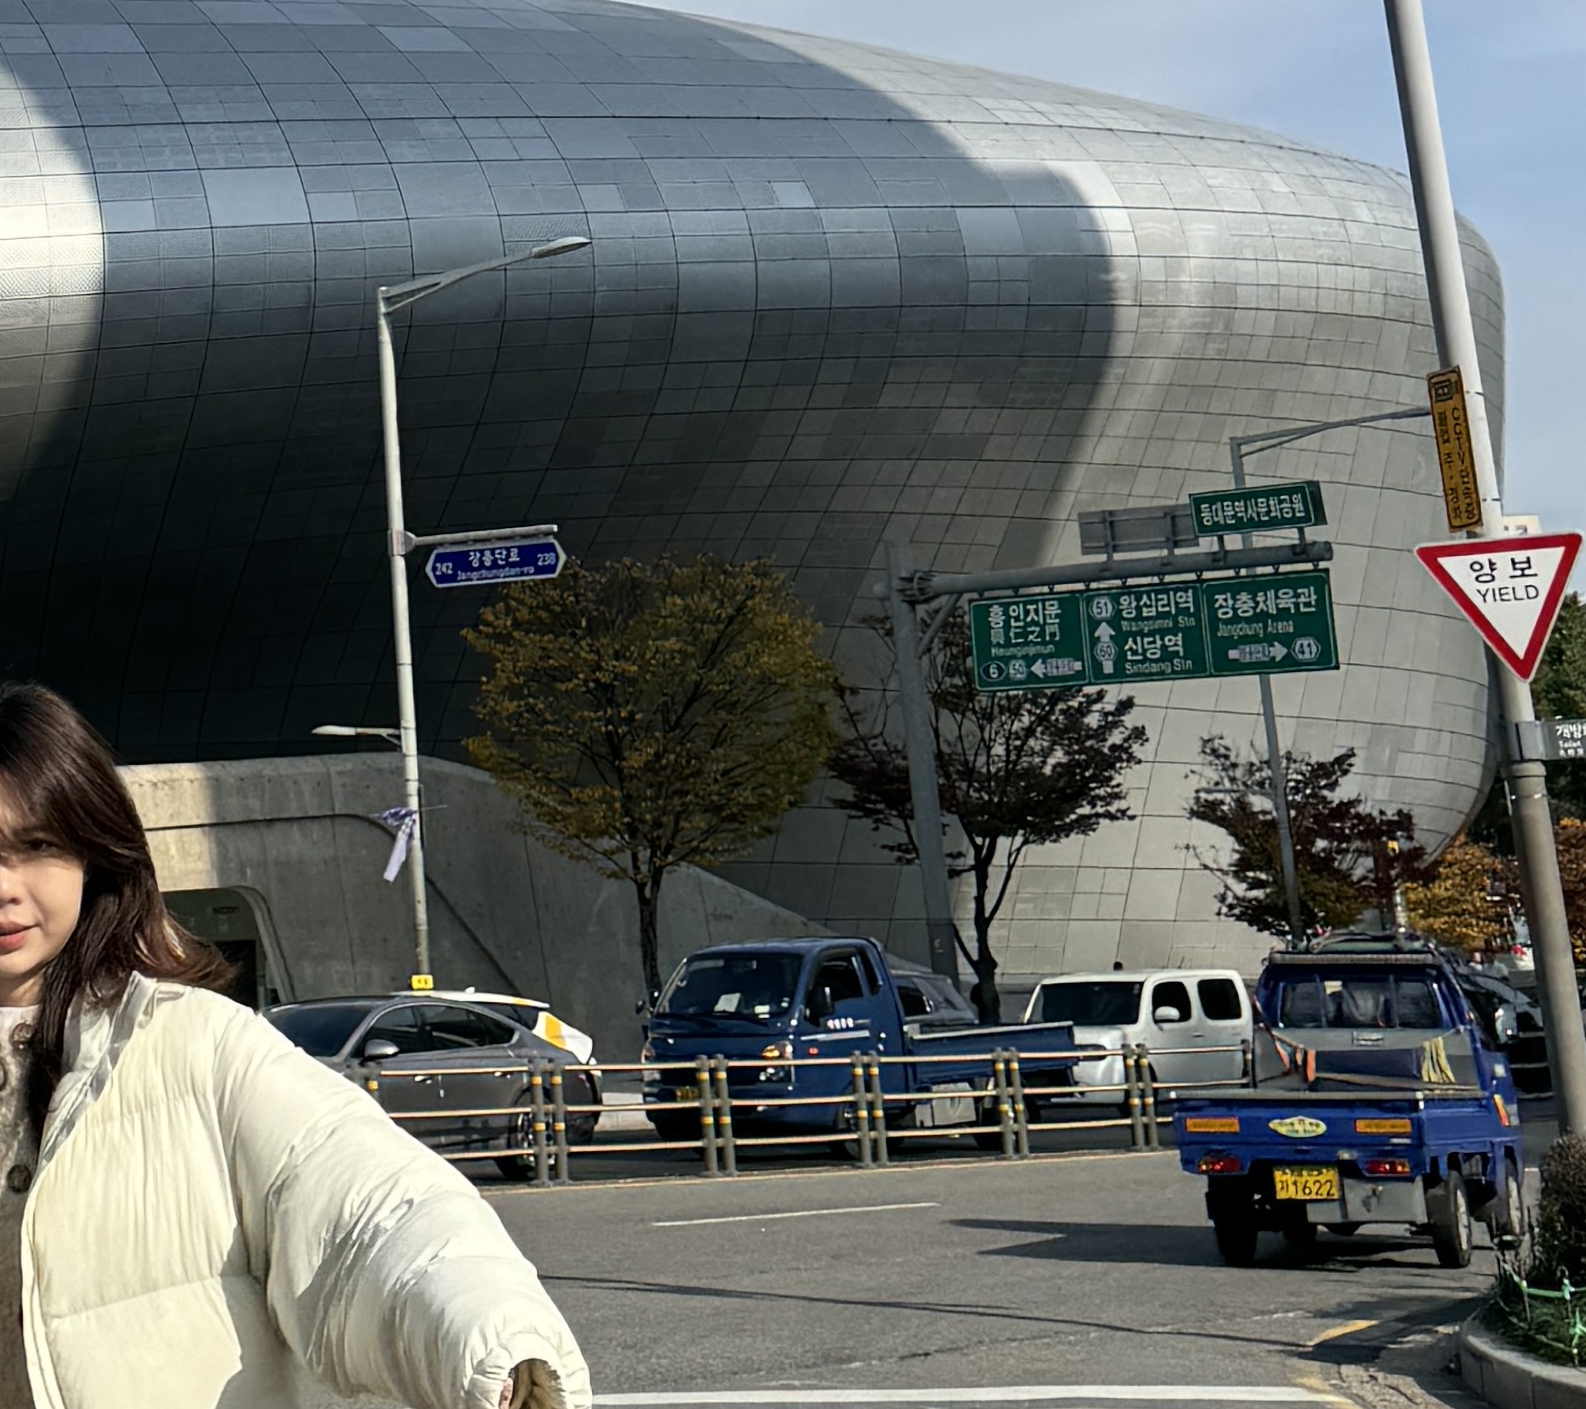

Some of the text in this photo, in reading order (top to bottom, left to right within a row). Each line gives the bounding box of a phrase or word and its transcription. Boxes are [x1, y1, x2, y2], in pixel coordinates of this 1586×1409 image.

[1200, 492, 1306, 526] 동대문역사문화공원
[1119, 588, 1194, 619] 왕십리역
[1214, 586, 1318, 619] 장충체육관
[1476, 584, 1539, 604] YIELD
[987, 599, 1062, 629] 흥인지문
[1095, 599, 1111, 616] 51
[1217, 618, 1294, 639] Jangchung Arena
[1124, 632, 1185, 661] 신당역
[1297, 641, 1314, 657] 41
[988, 663, 1000, 679] 6
[1125, 661, 1172, 674] Sindang
